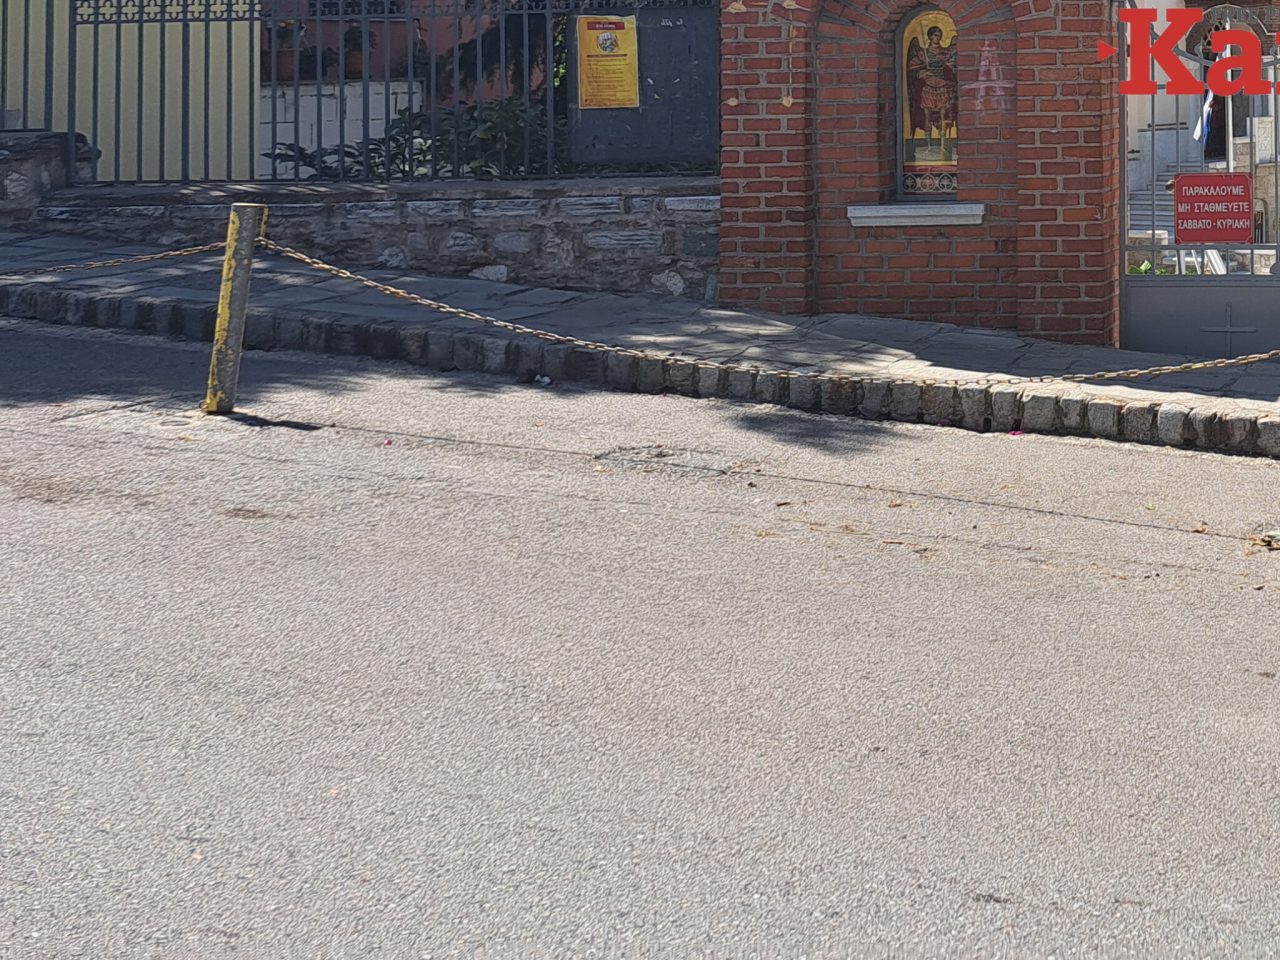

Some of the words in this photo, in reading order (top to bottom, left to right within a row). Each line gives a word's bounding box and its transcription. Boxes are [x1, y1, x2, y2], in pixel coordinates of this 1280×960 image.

[1182, 185, 1245, 196] ΠΑΡΑΚΑΛΟΥΜΕ
[1178, 203, 1191, 213] ΜΗ
[1194, 202, 1250, 212] ΣΤΑΘΜΕΥΕΤΕ
[1178, 219, 1212, 229] ΣΑΒΒΑΤΟ
[1216, 218, 1250, 229] ΚΥΡΙΑΚΗ
